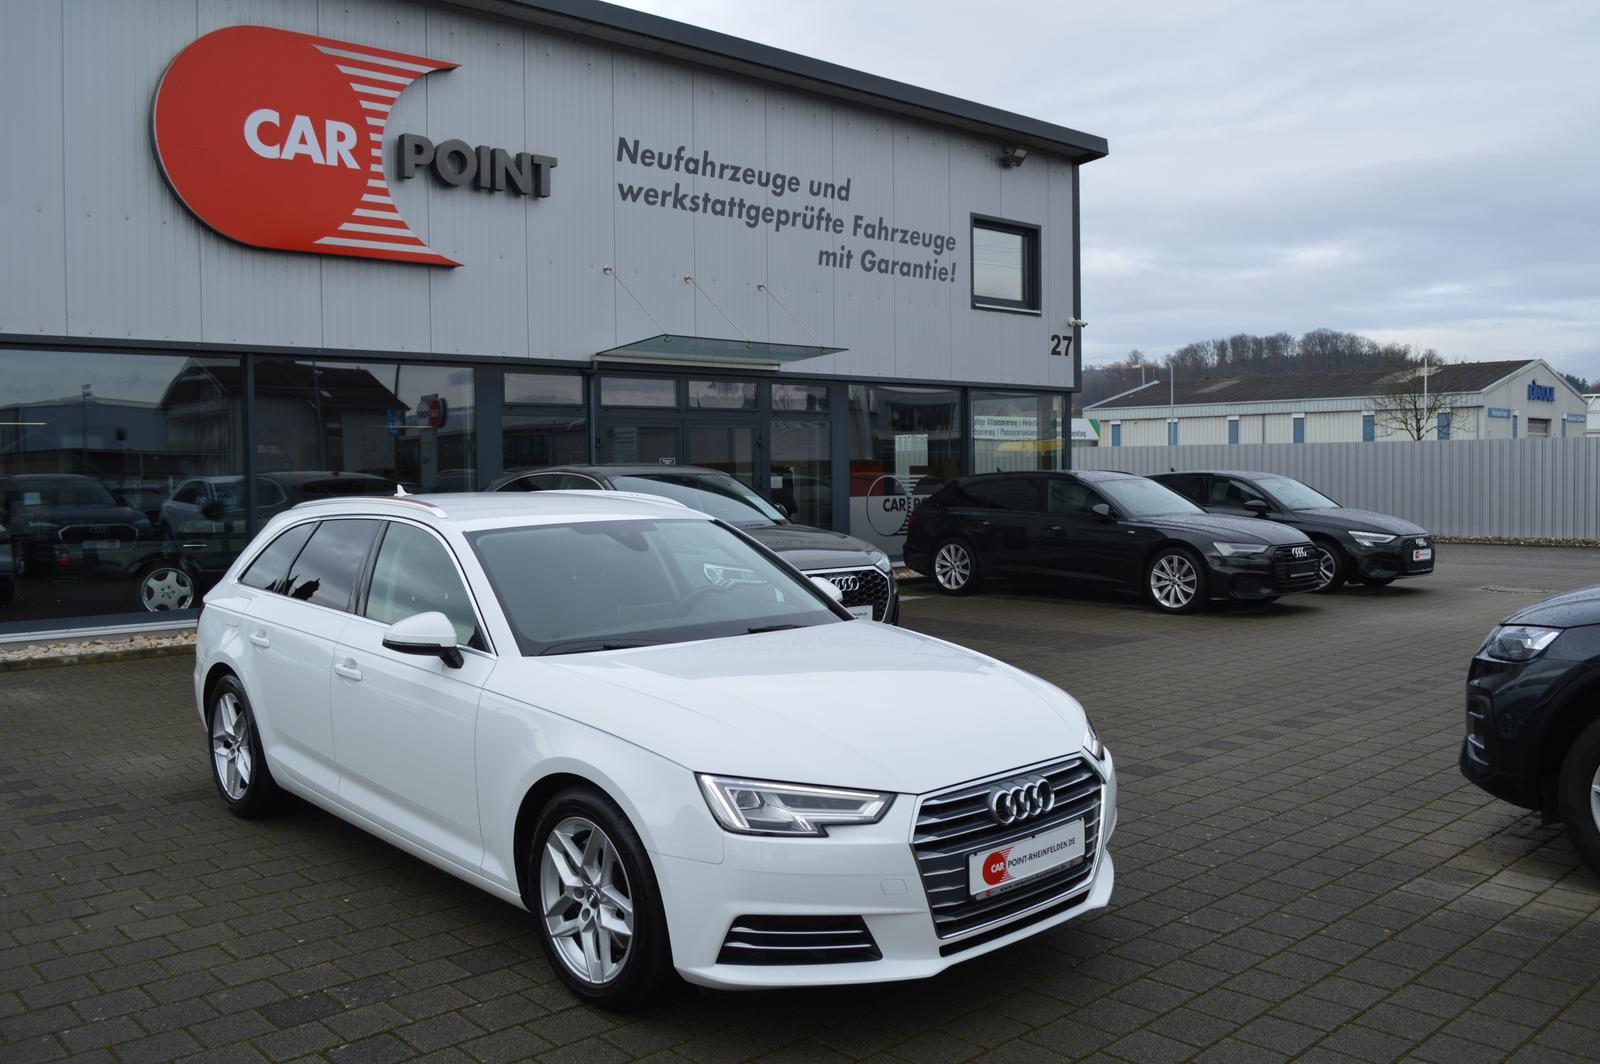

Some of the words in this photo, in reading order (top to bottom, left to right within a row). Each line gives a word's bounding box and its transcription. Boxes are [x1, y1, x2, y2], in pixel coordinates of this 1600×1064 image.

[244, 108, 361, 170] CAR
[398, 133, 558, 199] POINT
[616, 137, 800, 196] Neufahrzeuge
[808, 178, 851, 202] und
[617, 182, 845, 234] werkstattgeprüfte
[852, 215, 957, 252] Fahrzeuge
[817, 246, 853, 270] mit
[860, 250, 957, 282] Garantie!
[1050, 334, 1073, 356] 27
[883, 498, 906, 512] CAR
[991, 862, 1005, 873] CAR
[1007, 837, 1076, 868] POINT-RHEINFELDEN.DE
